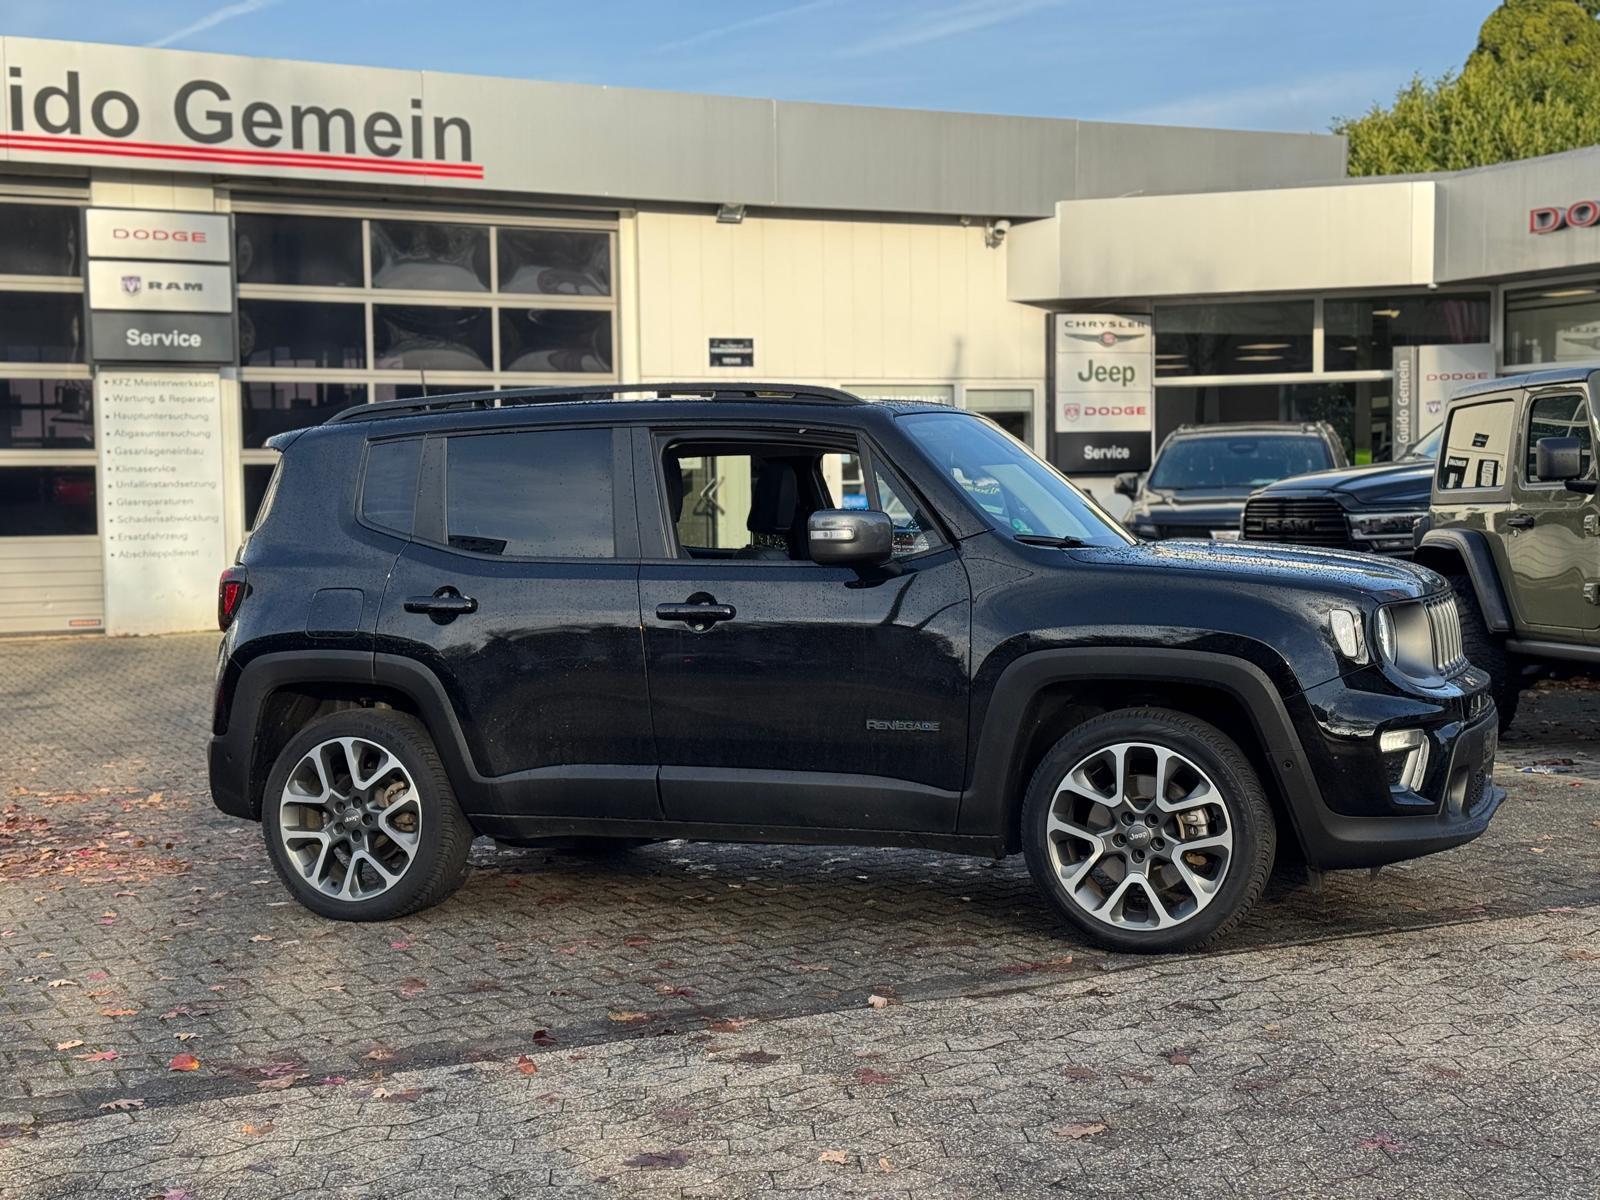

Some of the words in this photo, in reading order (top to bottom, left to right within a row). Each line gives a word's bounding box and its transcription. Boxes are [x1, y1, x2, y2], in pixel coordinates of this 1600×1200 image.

[10, 66, 140, 139] ido
[173, 79, 473, 164] Gemein
[113, 229, 207, 243] DODGE
[148, 281, 203, 292] RAM
[1064, 320, 1146, 328] CHRYSLER
[125, 328, 202, 347] Service
[1077, 359, 1135, 387] Jeep
[1426, 372, 1488, 381] DODGE
[112, 378, 131, 387] KFZ
[134, 378, 215, 388] Meisterwerkstatt
[1396, 360, 1410, 406] Gemein
[112, 394, 155, 404] Wartung
[158, 393, 166, 403] &
[168, 394, 216, 404] Reparatur
[113, 411, 209, 422] Hauptuntersuchung
[1084, 406, 1146, 416] DODGE
[1396, 409, 1410, 444] Guido
[113, 428, 211, 439] Abgasuntersuchung
[114, 446, 204, 457] Gasanlageneinbau
[1083, 445, 1130, 460] Service
[115, 463, 176, 473] Klimaservice
[115, 480, 217, 490] Unfallinstandsetzung
[116, 497, 194, 508] Glasreparaturen
[117, 513, 219, 524] Schadensabwicklung
[117, 531, 188, 542] Ersatzfahrzeug
[118, 549, 199, 560] Abschleppdienst
